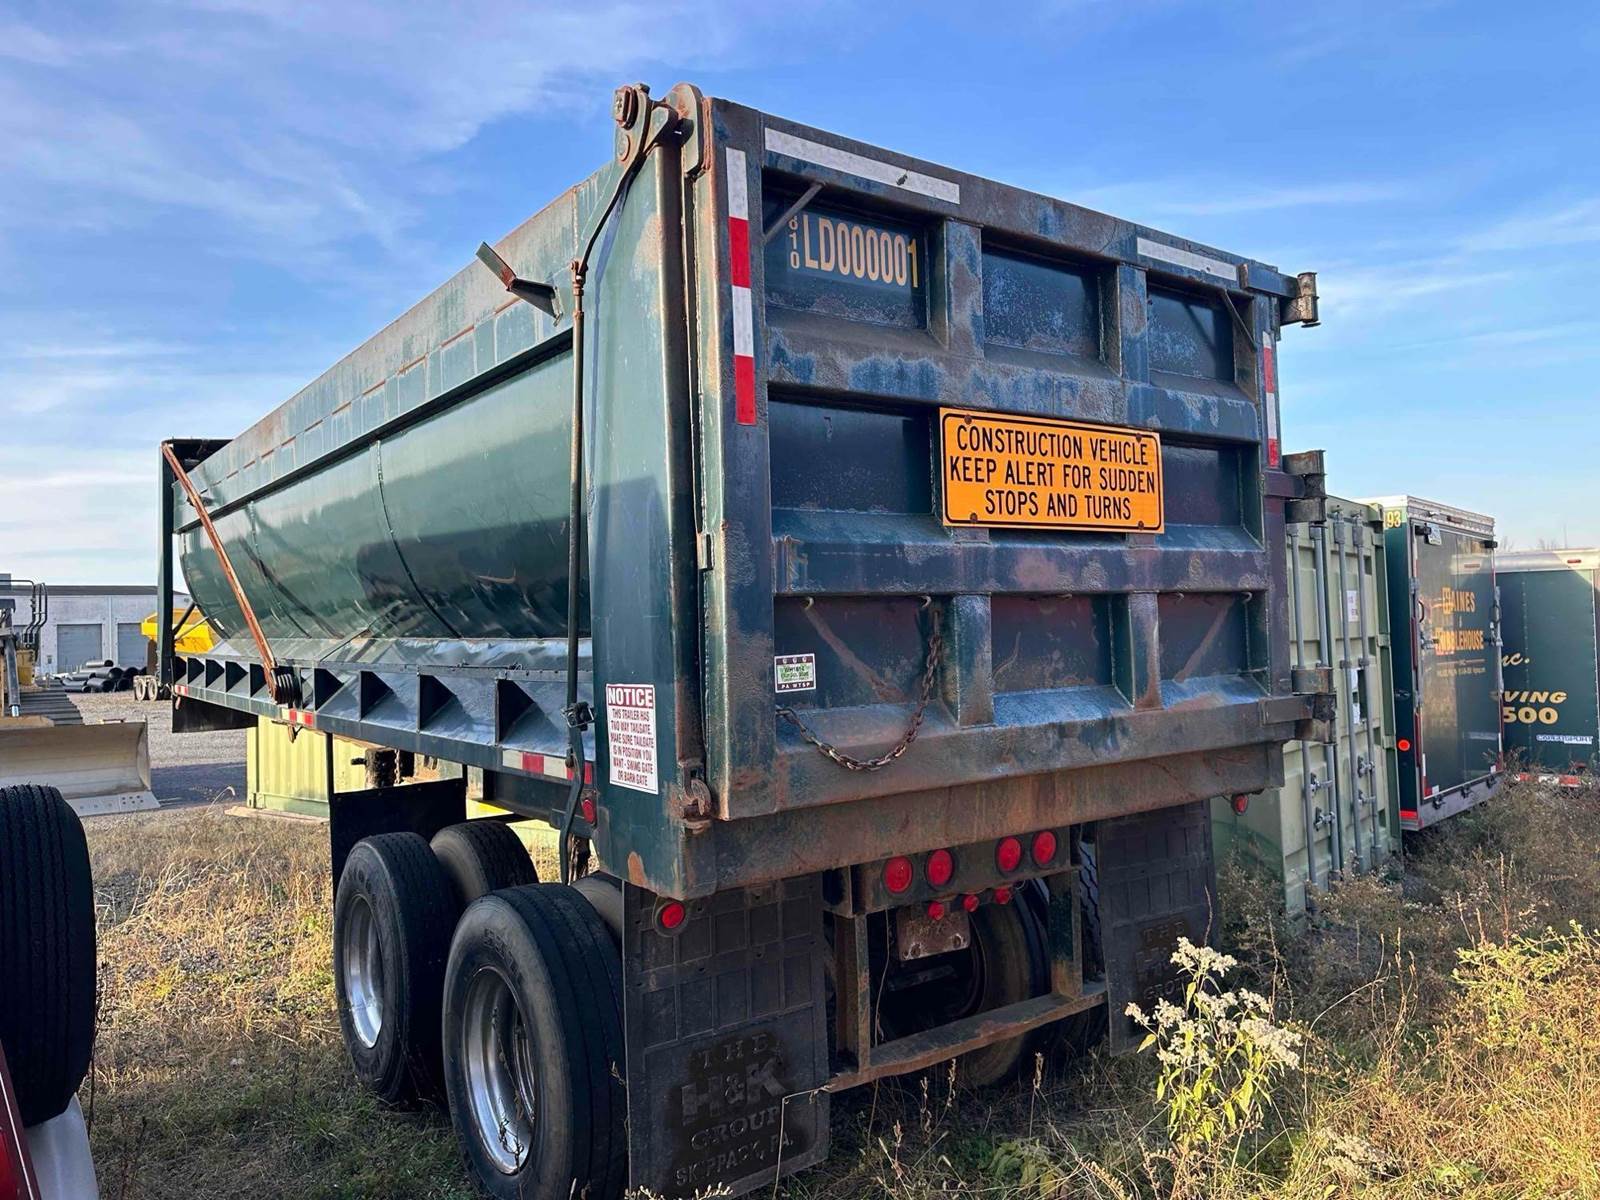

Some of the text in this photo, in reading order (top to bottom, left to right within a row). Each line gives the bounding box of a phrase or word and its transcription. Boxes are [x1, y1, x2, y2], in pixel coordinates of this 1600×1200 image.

[803, 214, 919, 289] LD000001
[957, 424, 1149, 466] CONSTRUCTION VEHICLE
[949, 455, 1156, 494] KEEP ALERT FOR SUDDEN
[984, 489, 1132, 521] STOPS AND TURNS
[608, 687, 654, 707] NOTICE
[1503, 690, 1568, 704] VING
[612, 708, 621, 719] THIS
[622, 709, 639, 720] TRAILER
[1503, 706, 1559, 725] 500
[610, 732, 622, 744] MAKE
[622, 734, 633, 745] SURE
[622, 746, 642, 759] POSITION
[643, 749, 652, 761] YOU
[641, 762, 654, 775] GATE
